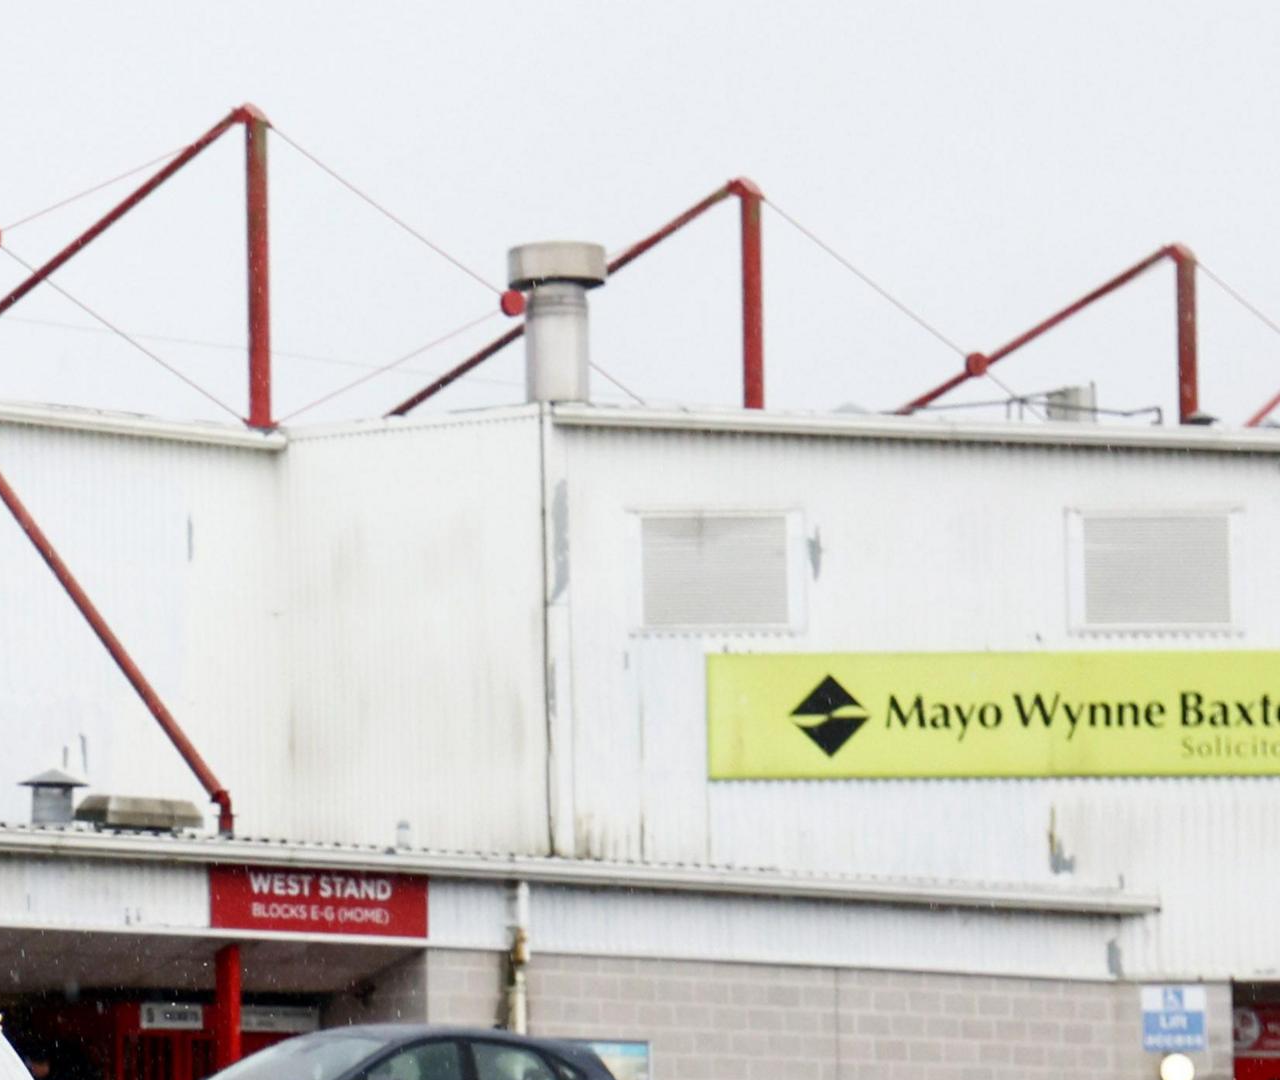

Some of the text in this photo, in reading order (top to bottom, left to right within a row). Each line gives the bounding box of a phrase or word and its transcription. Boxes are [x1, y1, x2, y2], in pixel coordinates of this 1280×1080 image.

[885, 694, 1003, 741] Mayo
[1014, 692, 1166, 740] Wynne
[250, 871, 392, 901] WEST STAND
[252, 902, 389, 925] BLOCKS E-G (HOME)
